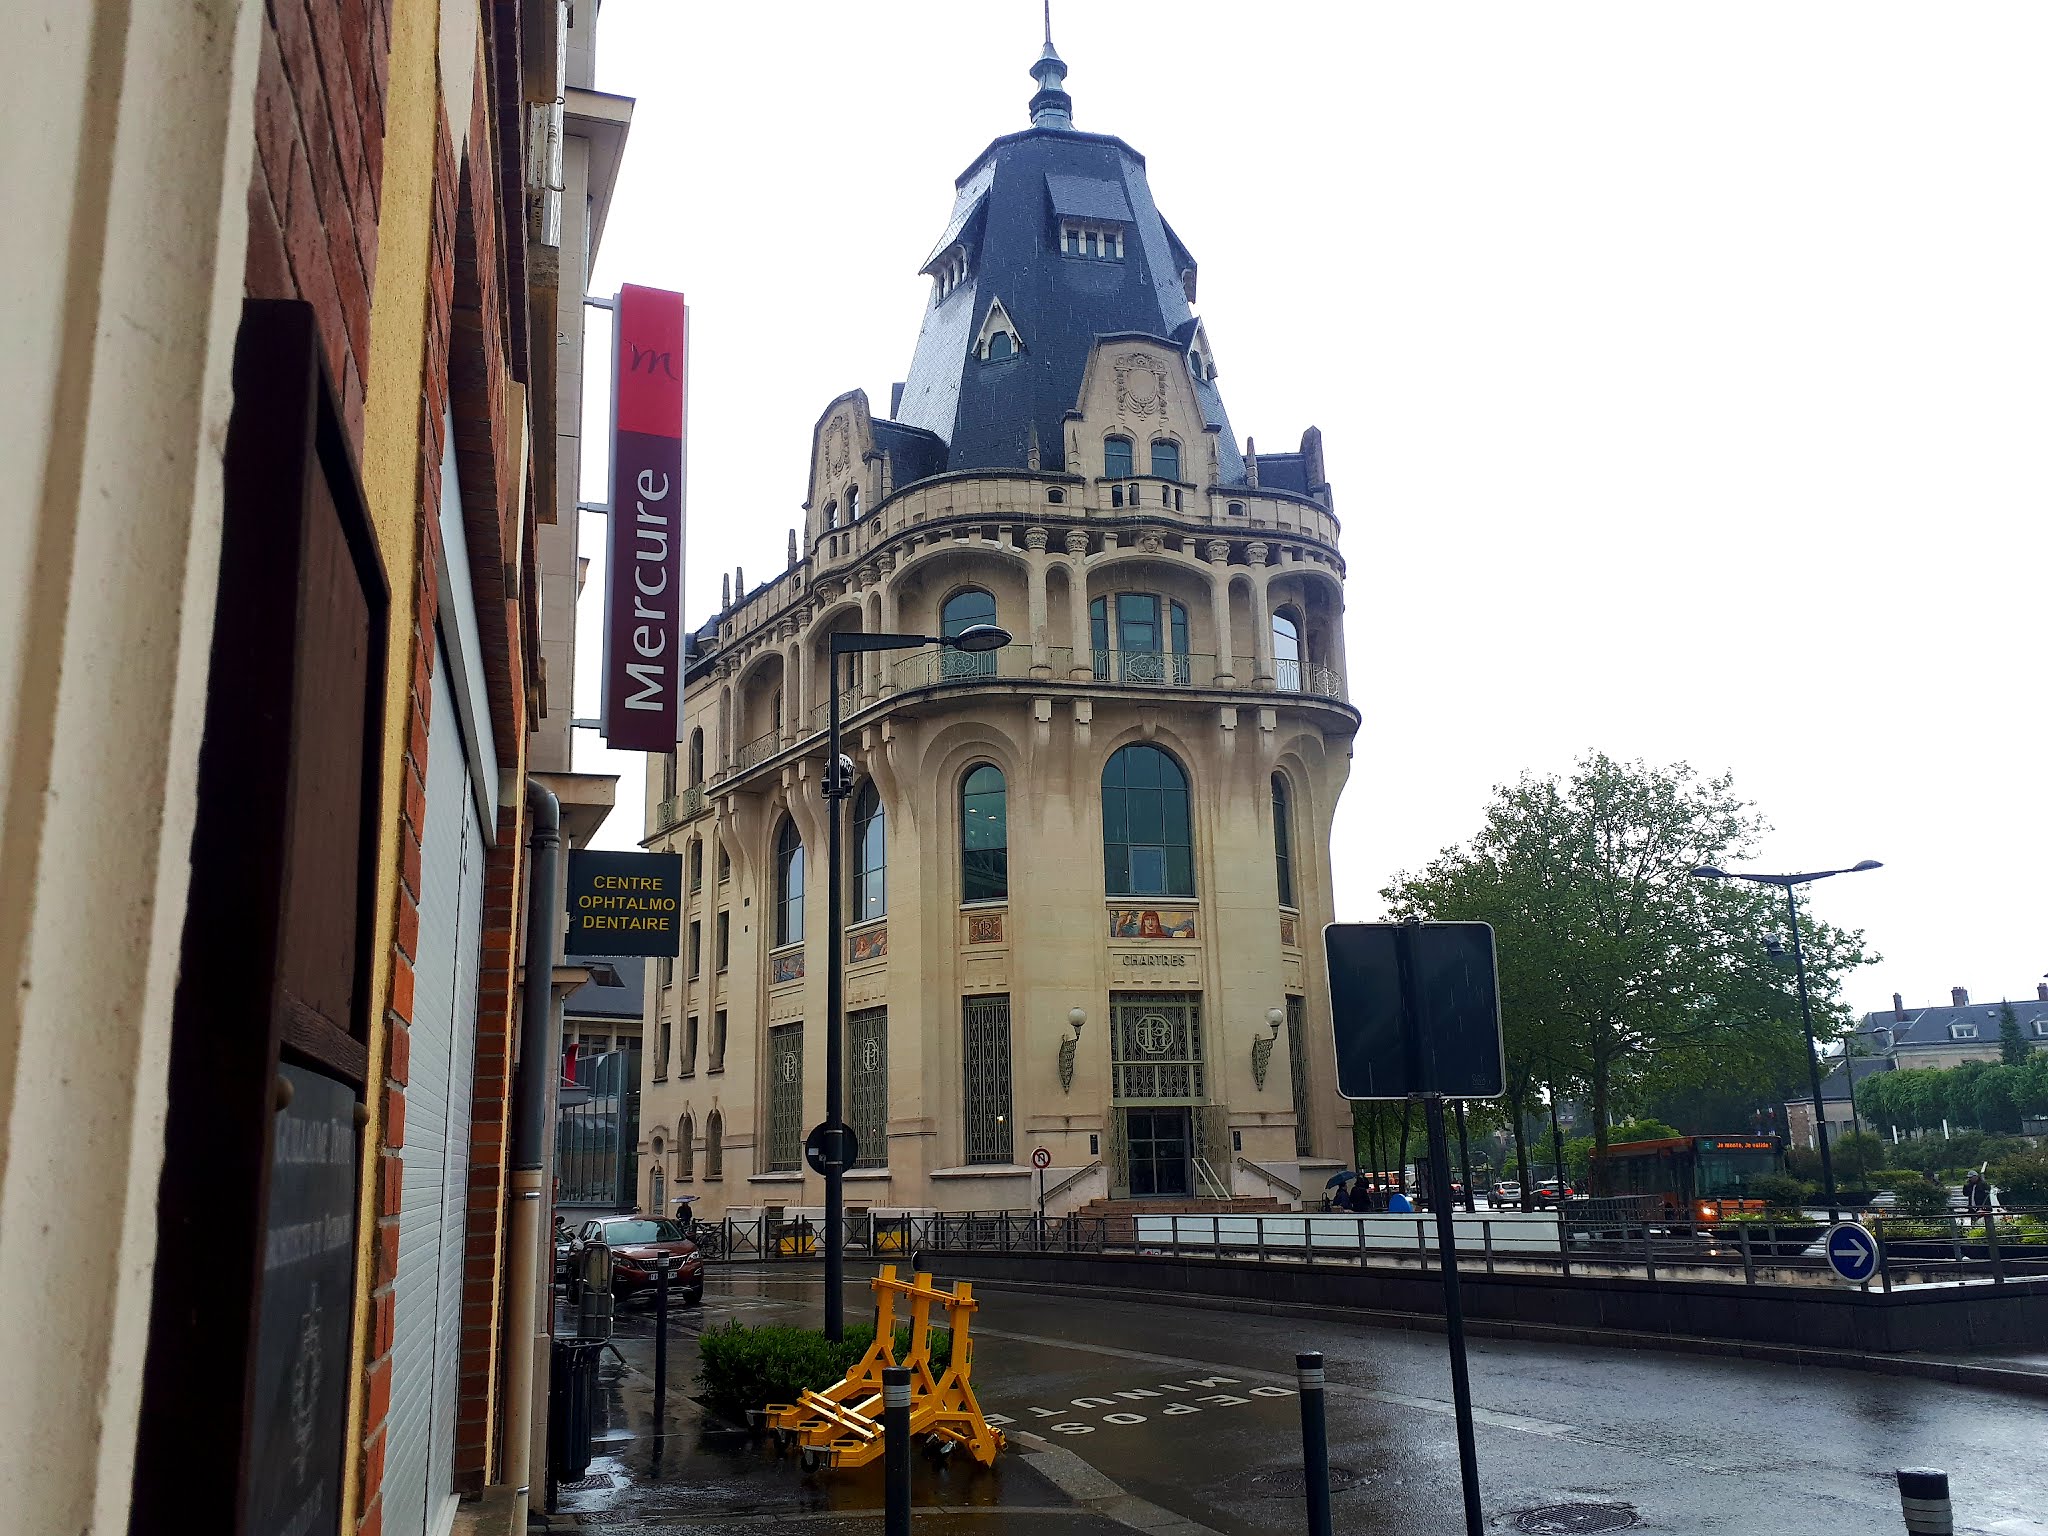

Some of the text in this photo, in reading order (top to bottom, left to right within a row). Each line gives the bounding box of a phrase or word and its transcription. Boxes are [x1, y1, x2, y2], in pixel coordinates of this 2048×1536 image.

[624, 469, 669, 712] Mercure
[593, 875, 663, 891] CENTRE
[578, 895, 676, 911] OPHTALMO
[583, 915, 670, 931] DENTAIRE
[1122, 954, 1185, 967] CHARTRES
[983, 1376, 1243, 1426] MINUTE
